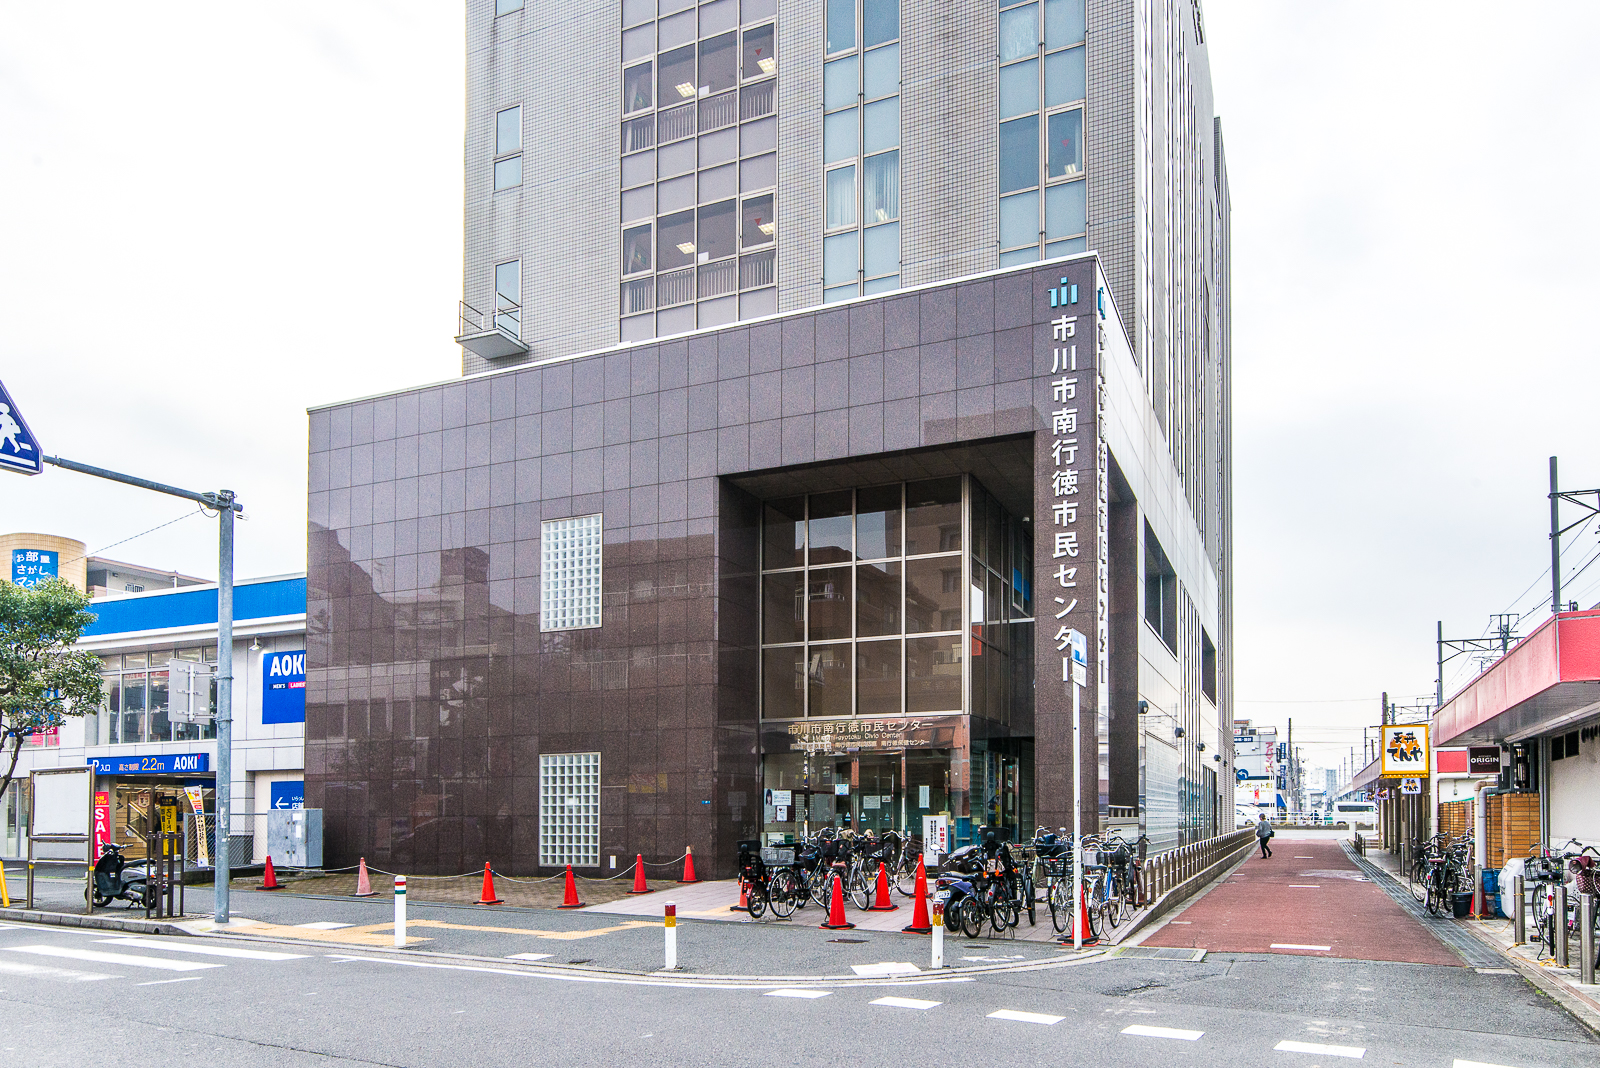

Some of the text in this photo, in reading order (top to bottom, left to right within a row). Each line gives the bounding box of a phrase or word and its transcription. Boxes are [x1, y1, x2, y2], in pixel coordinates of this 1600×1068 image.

[1051, 315, 1079, 682] 市川市南行徳市民センター
[16, 551, 50, 563] お部屋
[17, 564, 49, 575] さがし
[788, 720, 933, 734] 市川市南行徳市民センター
[1387, 747, 1423, 762] てんや
[142, 758, 164, 771] 2.2m
[174, 755, 198, 770] AOKI
[95, 808, 106, 858] SALE
